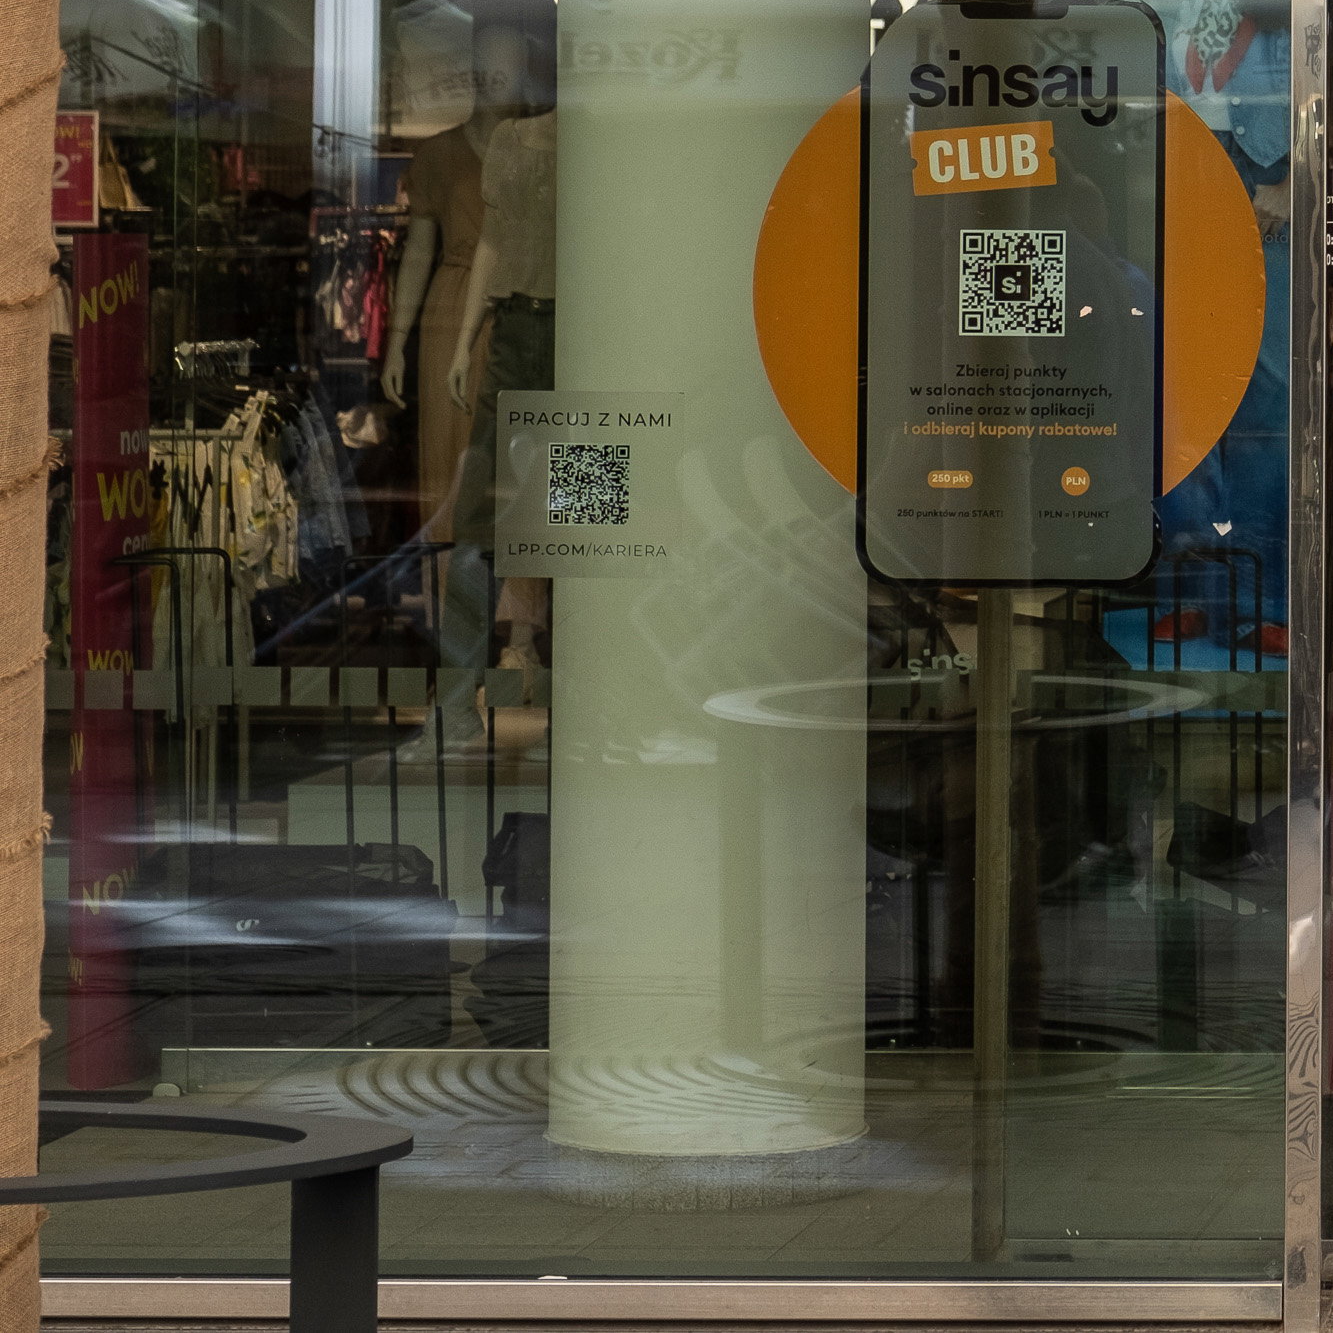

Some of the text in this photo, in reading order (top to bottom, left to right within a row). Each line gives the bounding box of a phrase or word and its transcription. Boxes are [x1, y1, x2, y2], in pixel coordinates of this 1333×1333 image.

[908, 49, 1119, 127] sinsay
[928, 133, 1039, 184] CLUB
[79, 260, 140, 329] NOW!
[956, 364, 1067, 380] Zbieraj punkty
[909, 383, 1113, 400] w salonach stacjonarnych,
[927, 402, 1095, 419] online oraz w aplikacji
[509, 411, 672, 427] PRACUJ Z NAMI
[911, 422, 975, 439] odbieraj
[979, 422, 1034, 439] kupony
[1038, 422, 1118, 436] rabatowe!
[931, 473, 970, 485] 250 pkt
[1066, 476, 1086, 486] PLN
[916, 508, 956, 519] punktów
[508, 542, 668, 557] LPP.COM/KARIERA
